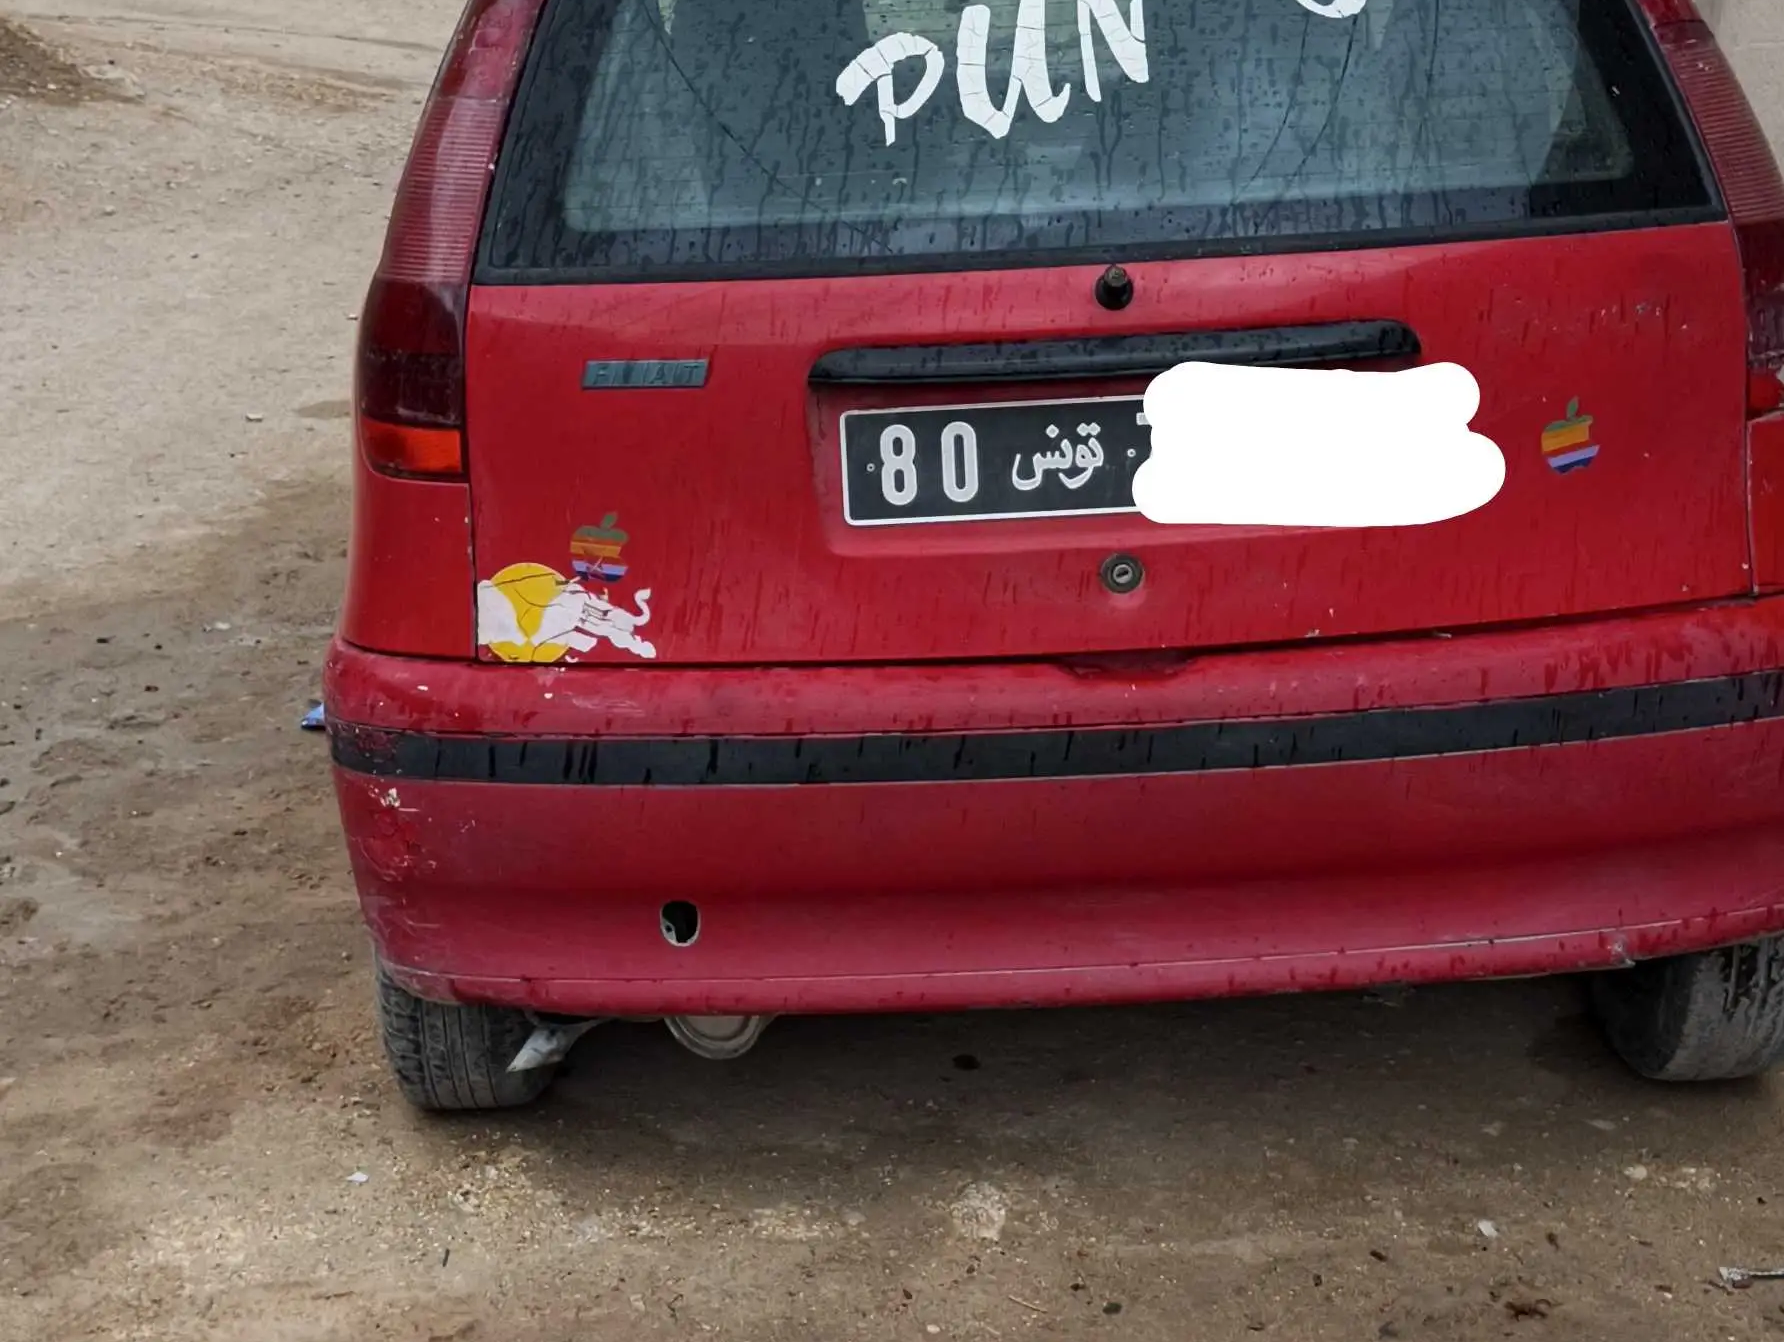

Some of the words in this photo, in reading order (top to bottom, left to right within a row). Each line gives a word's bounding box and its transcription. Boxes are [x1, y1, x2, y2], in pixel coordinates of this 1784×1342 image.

[593, 362, 702, 385] FIAT
[880, 424, 979, 506] 80
[1011, 422, 1104, 491] تونس
